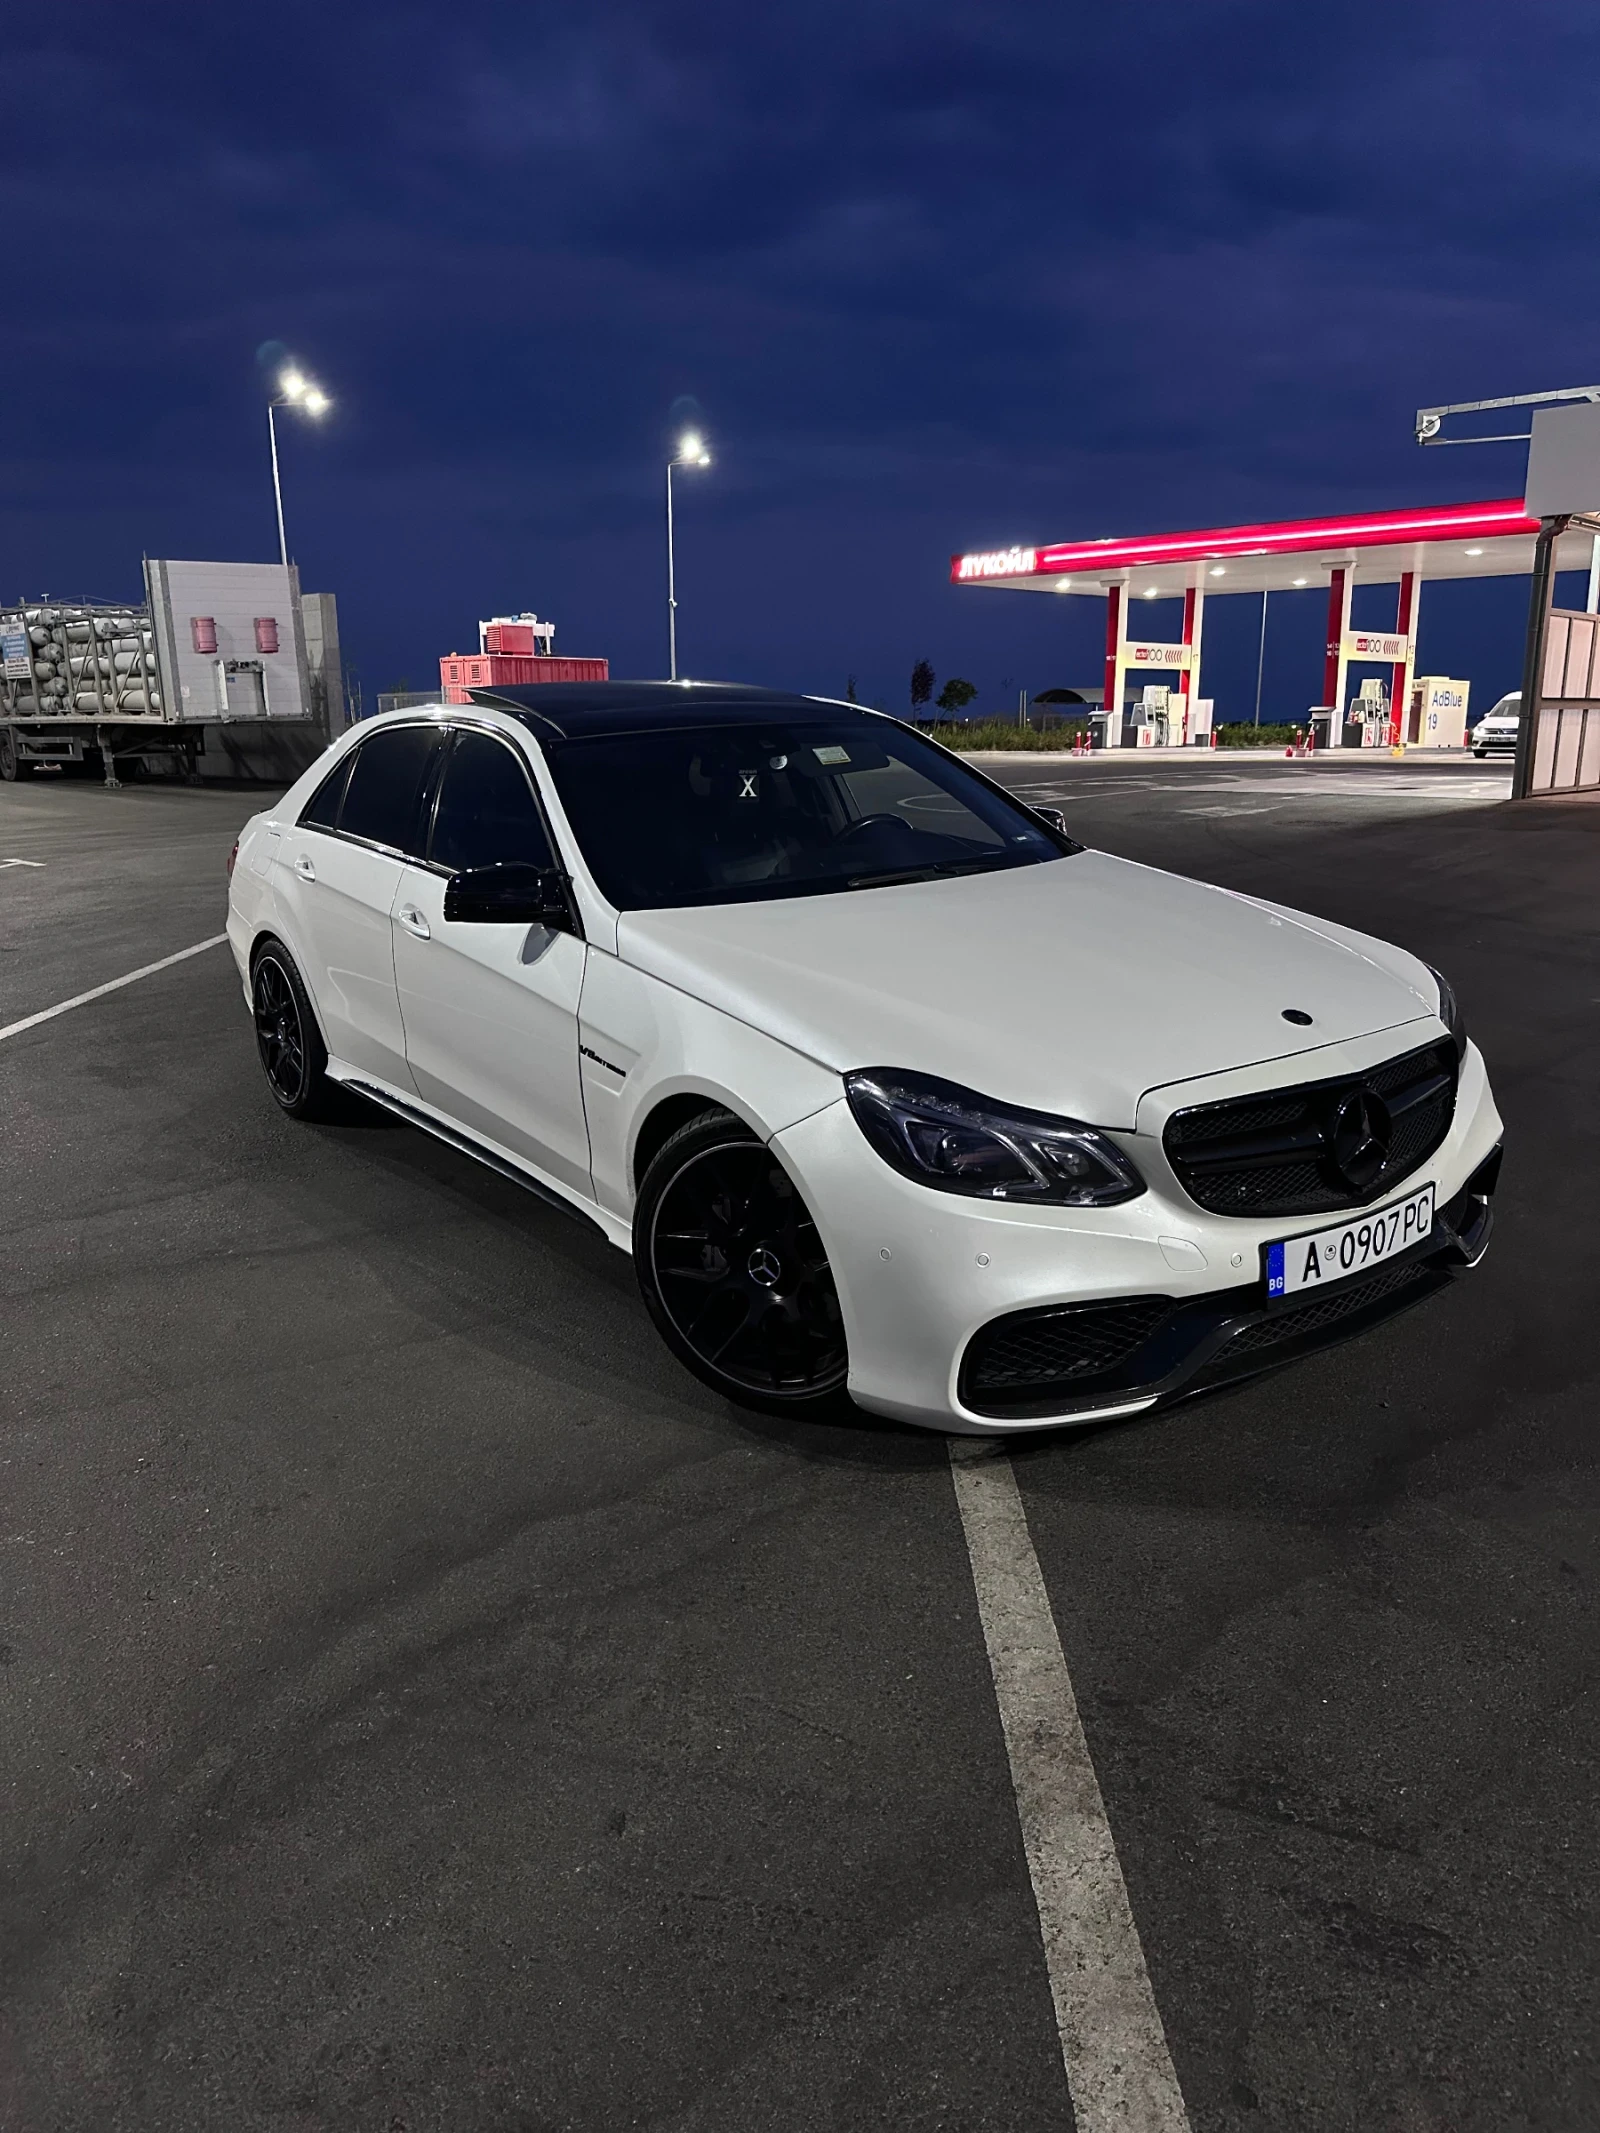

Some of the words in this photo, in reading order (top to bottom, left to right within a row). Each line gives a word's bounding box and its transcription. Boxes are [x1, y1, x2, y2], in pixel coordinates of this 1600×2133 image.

[1432, 690, 1462, 708] AdBlue
[1428, 714, 1438, 730] 19
[1302, 1241, 1322, 1282] A
[1268, 1276, 1284, 1291] BG
